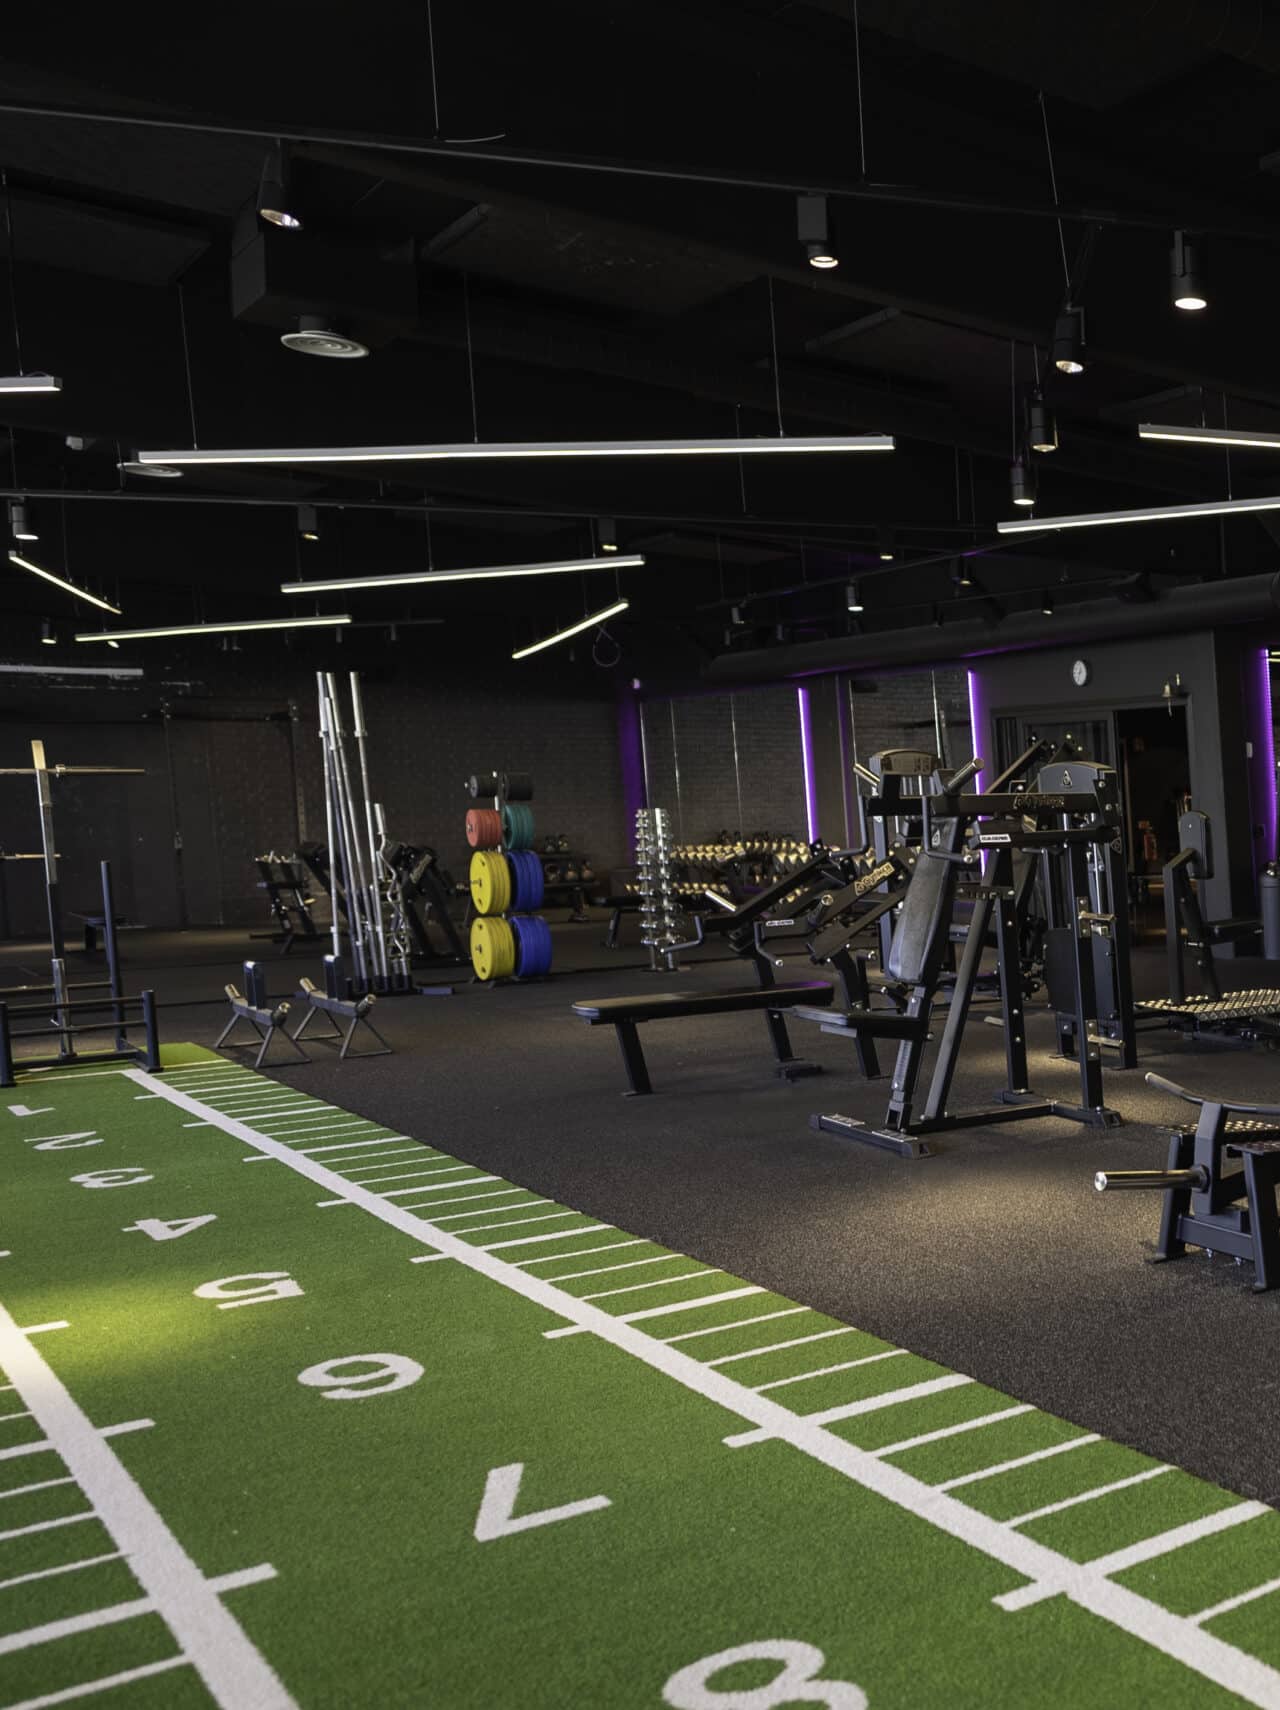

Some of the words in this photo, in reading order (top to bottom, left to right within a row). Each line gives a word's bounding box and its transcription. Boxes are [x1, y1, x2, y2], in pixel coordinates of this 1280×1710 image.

[8, 1105, 54, 1116] 1
[24, 1131, 104, 1150] 2
[70, 1168, 154, 1188] 3
[122, 1214, 217, 1241] 4
[193, 1272, 305, 1309] 5
[298, 1353, 424, 1399] 6
[474, 1463, 612, 1542] 7
